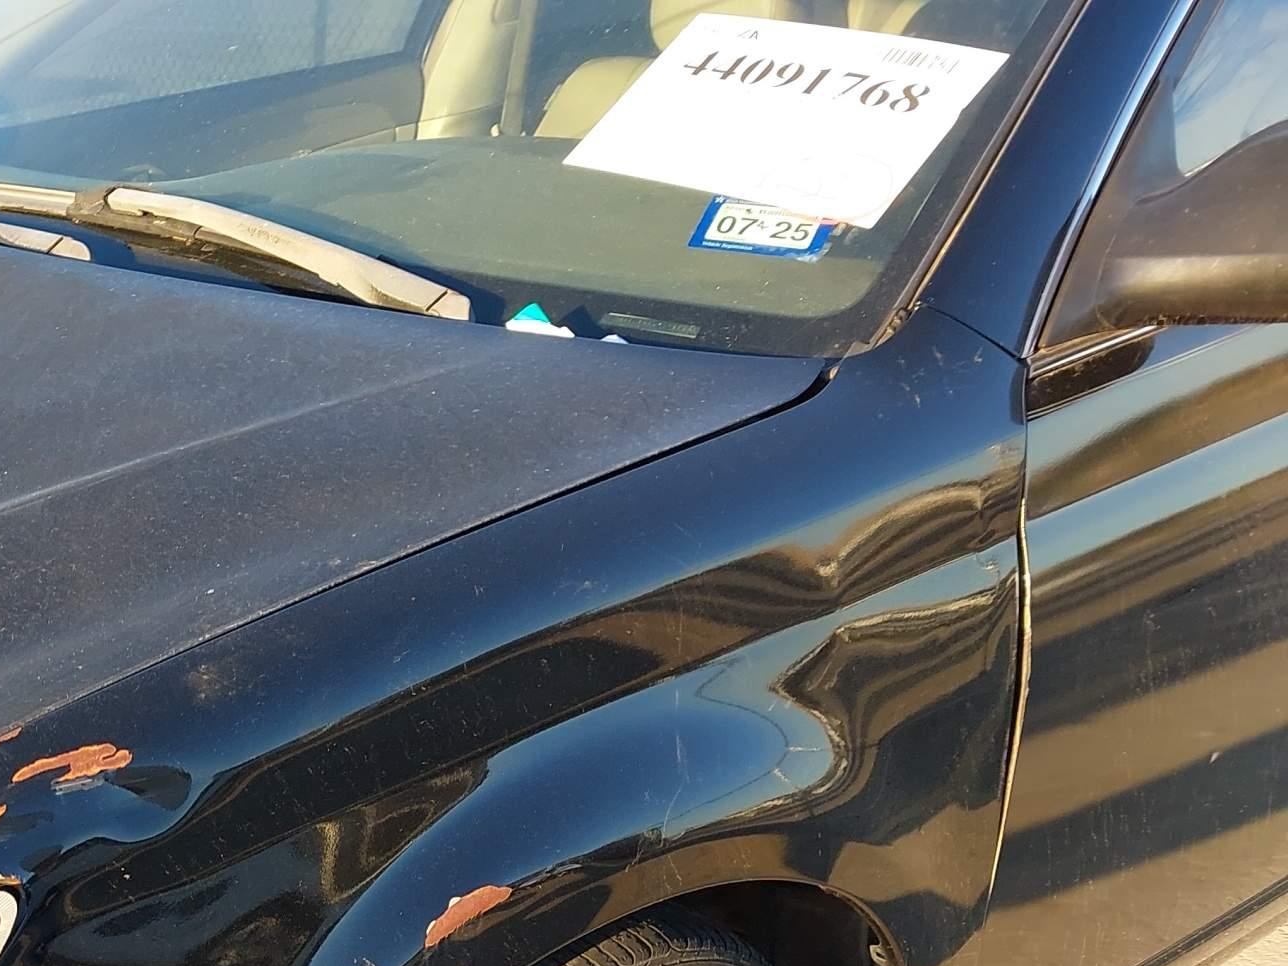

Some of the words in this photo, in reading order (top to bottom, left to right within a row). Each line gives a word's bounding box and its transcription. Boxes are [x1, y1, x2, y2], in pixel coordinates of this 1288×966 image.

[684, 50, 931, 112] 44091768
[716, 215, 759, 236] 07
[769, 220, 813, 241] 25
